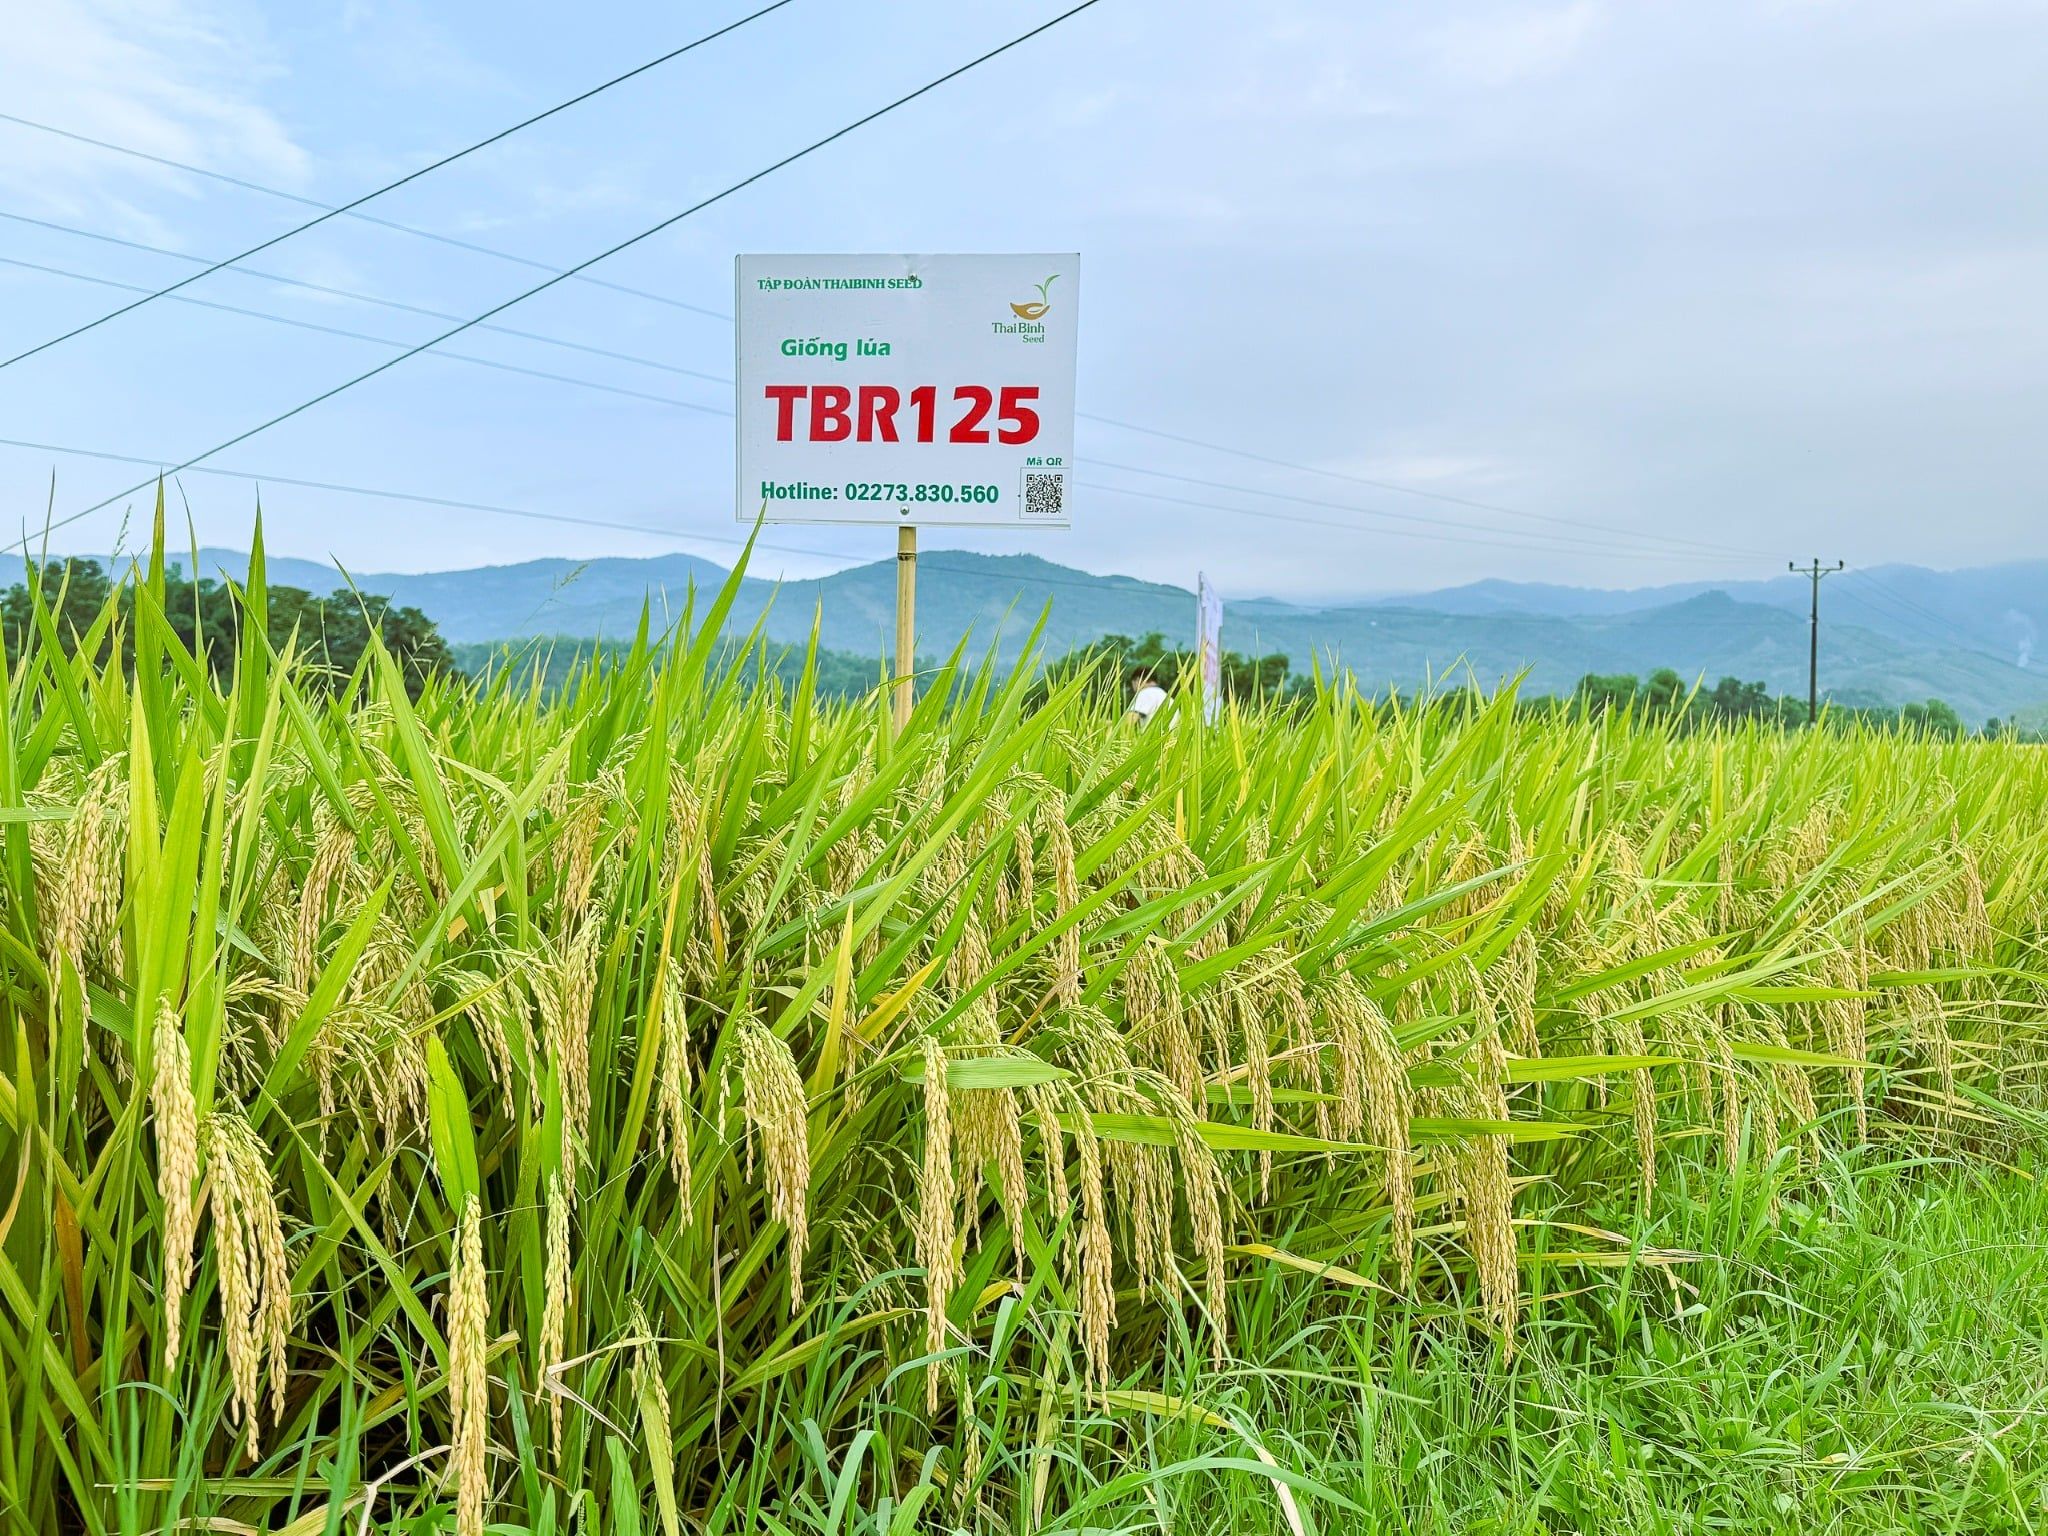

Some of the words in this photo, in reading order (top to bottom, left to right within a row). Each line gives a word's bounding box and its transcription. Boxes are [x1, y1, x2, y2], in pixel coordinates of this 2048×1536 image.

[823, 278, 885, 289] THAIBINH
[888, 278, 922, 289] SEED
[992, 322, 1016, 333] Thai
[1022, 334, 1044, 343] Seed
[781, 337, 848, 361] Giống
[856, 338, 891, 356] lúa
[765, 386, 1040, 445] TBR125
[1026, 456, 1042, 466] Mã
[1046, 457, 1062, 466] QR
[761, 481, 838, 500] Hotline:
[845, 483, 999, 503] 02273.830.560
